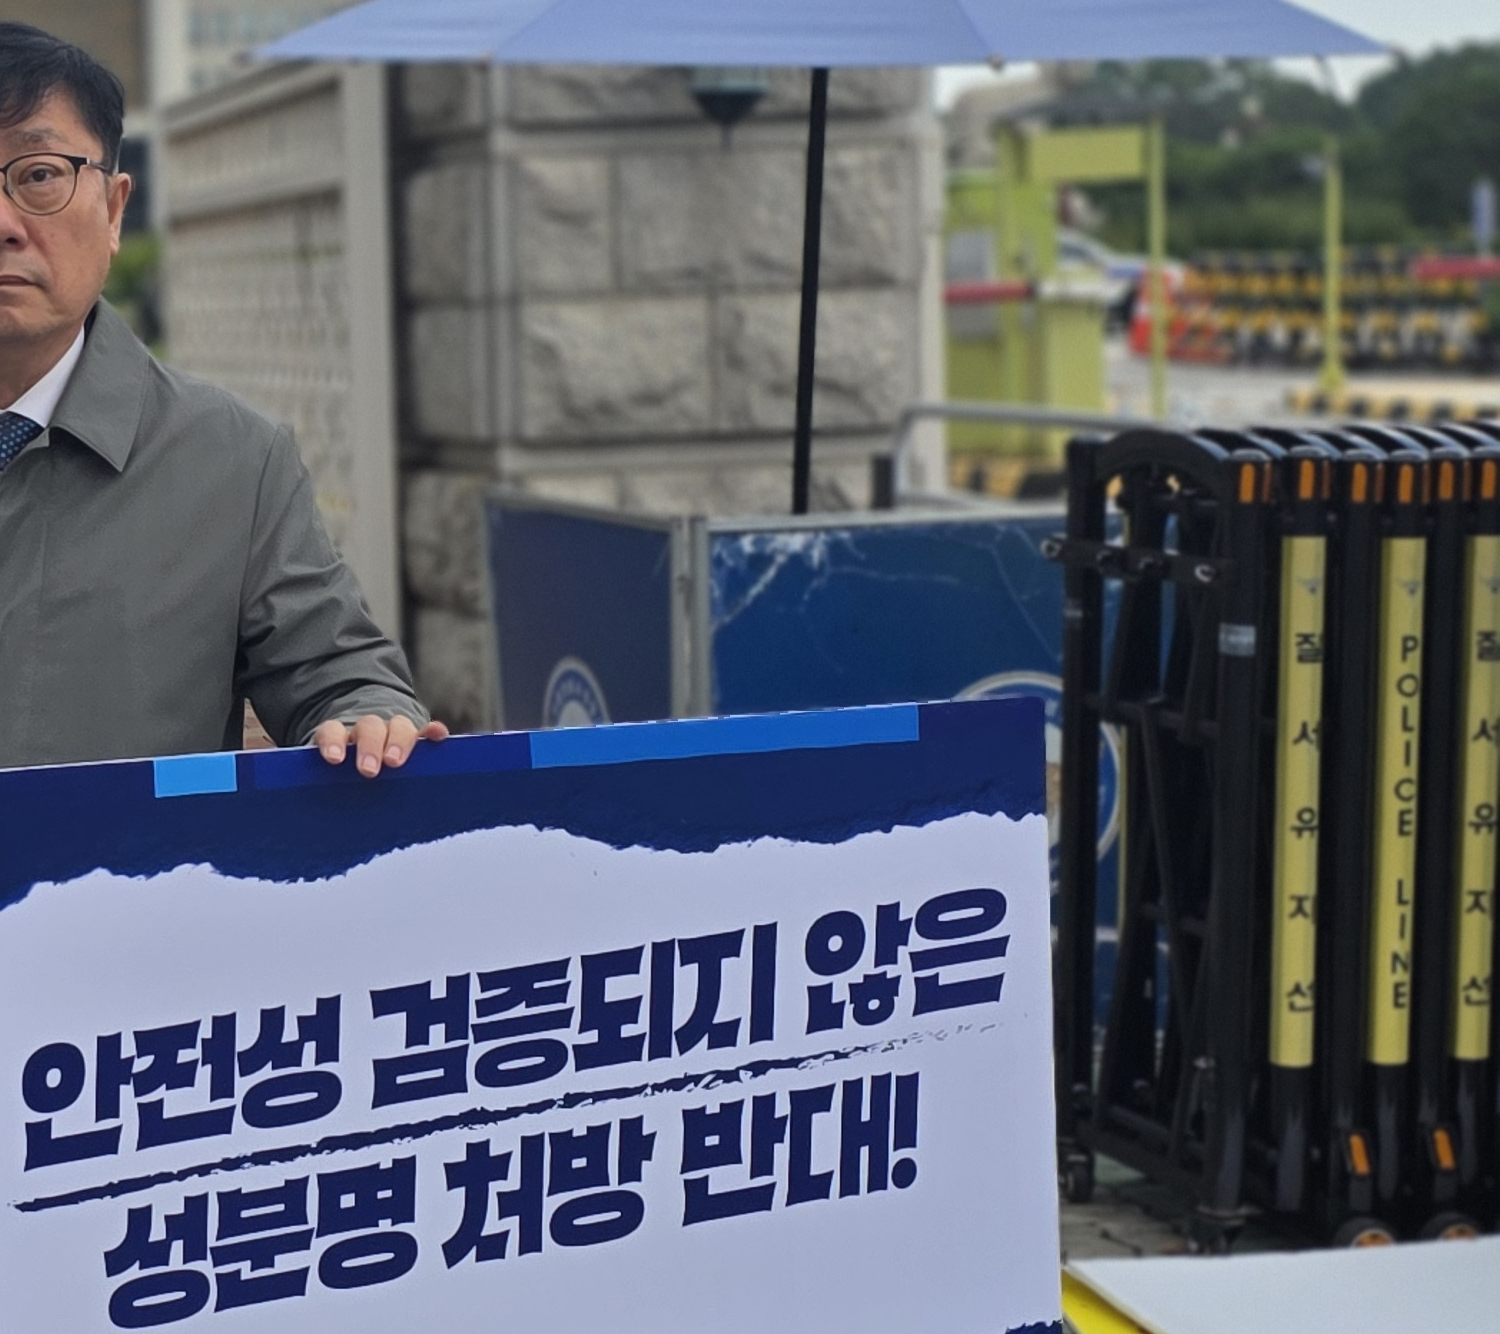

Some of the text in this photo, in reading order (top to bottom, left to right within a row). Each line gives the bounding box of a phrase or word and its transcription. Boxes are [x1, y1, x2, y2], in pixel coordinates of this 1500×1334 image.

[1391, 634, 1419, 1010] POLICE LINE
[22, 888, 1010, 1172] 안전성 검증되지 않은
[104, 1072, 919, 1329] 성분명 처방 반대!
